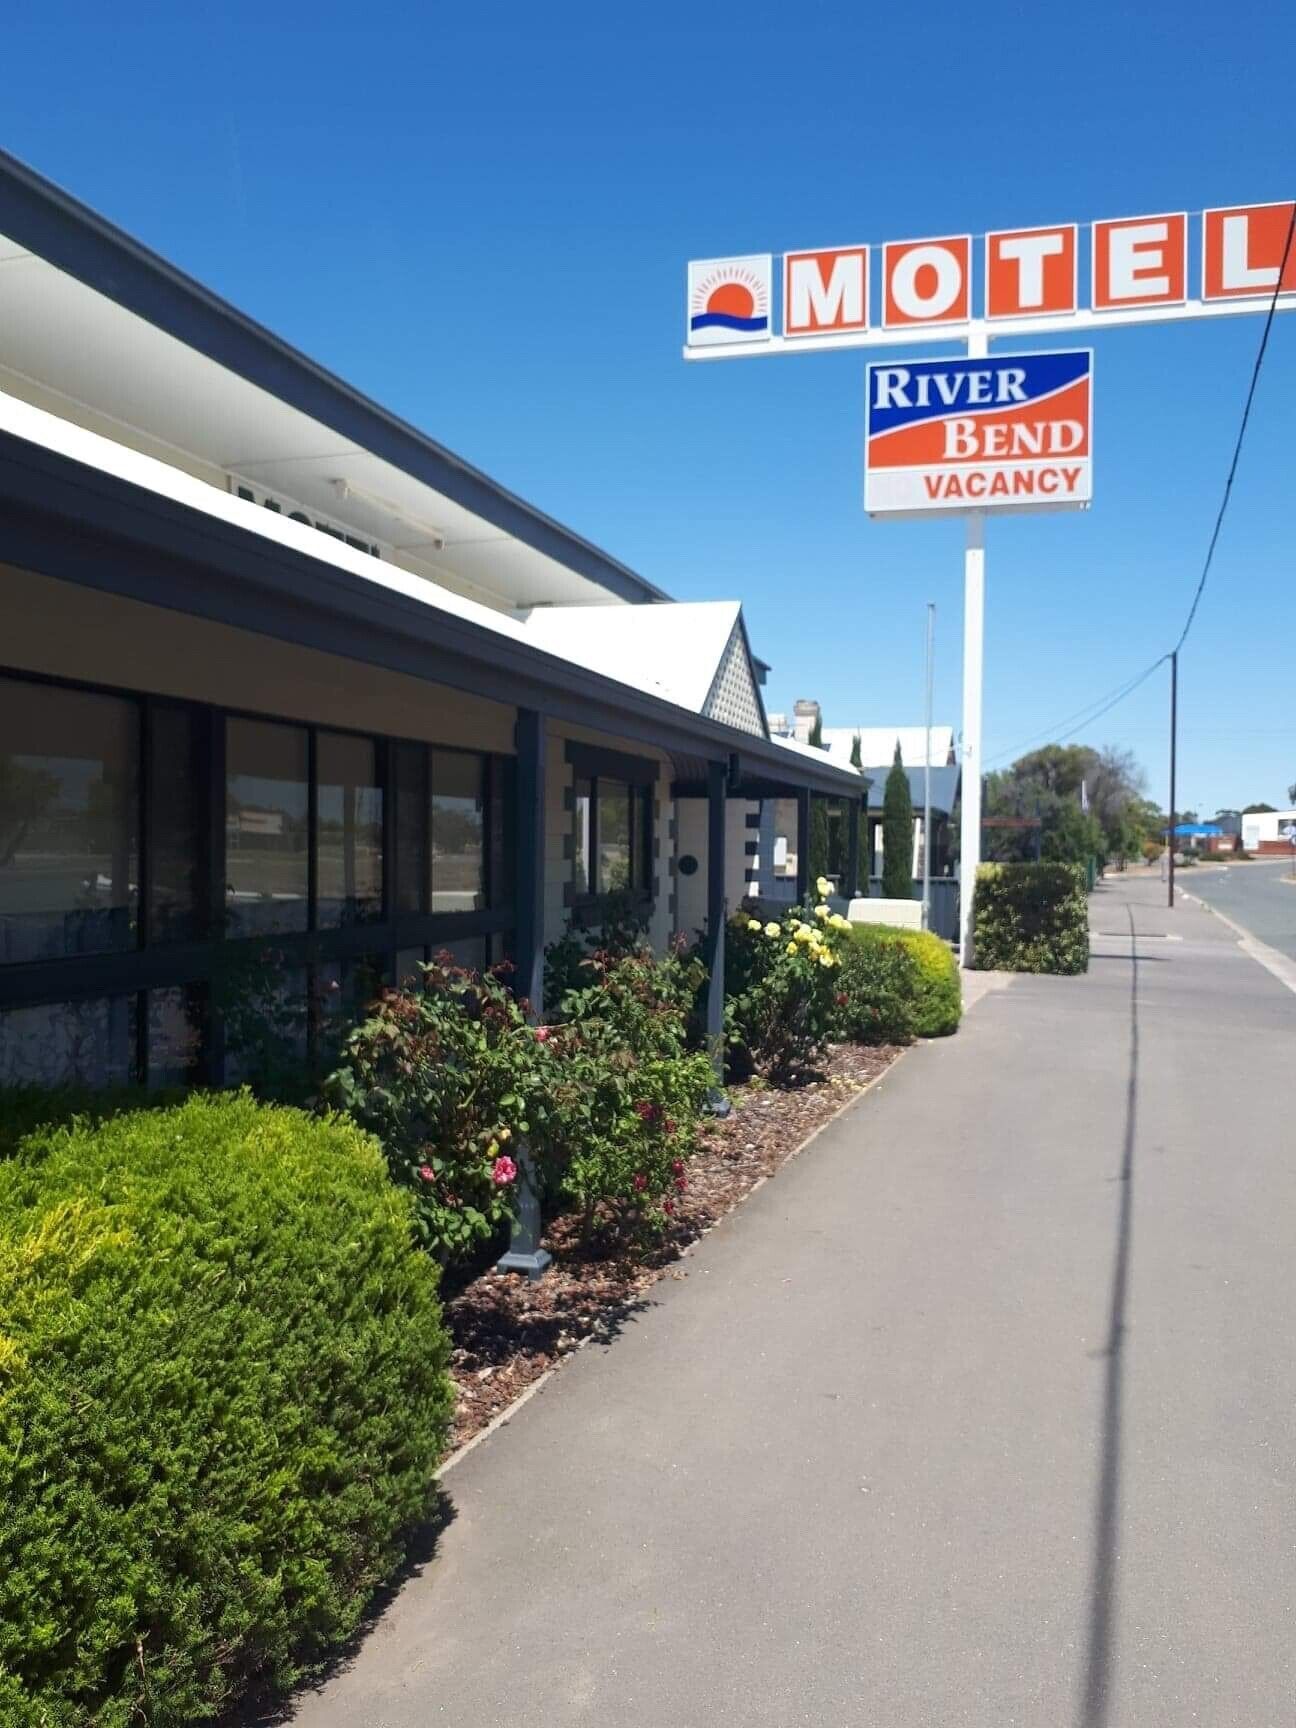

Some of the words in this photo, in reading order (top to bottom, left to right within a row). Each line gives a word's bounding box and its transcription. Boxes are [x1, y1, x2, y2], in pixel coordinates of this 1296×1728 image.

[790, 215, 1281, 329] MOTEL
[873, 368, 1029, 409] RIVER
[942, 418, 1084, 459] BEND
[923, 467, 1082, 499] VACANCY
